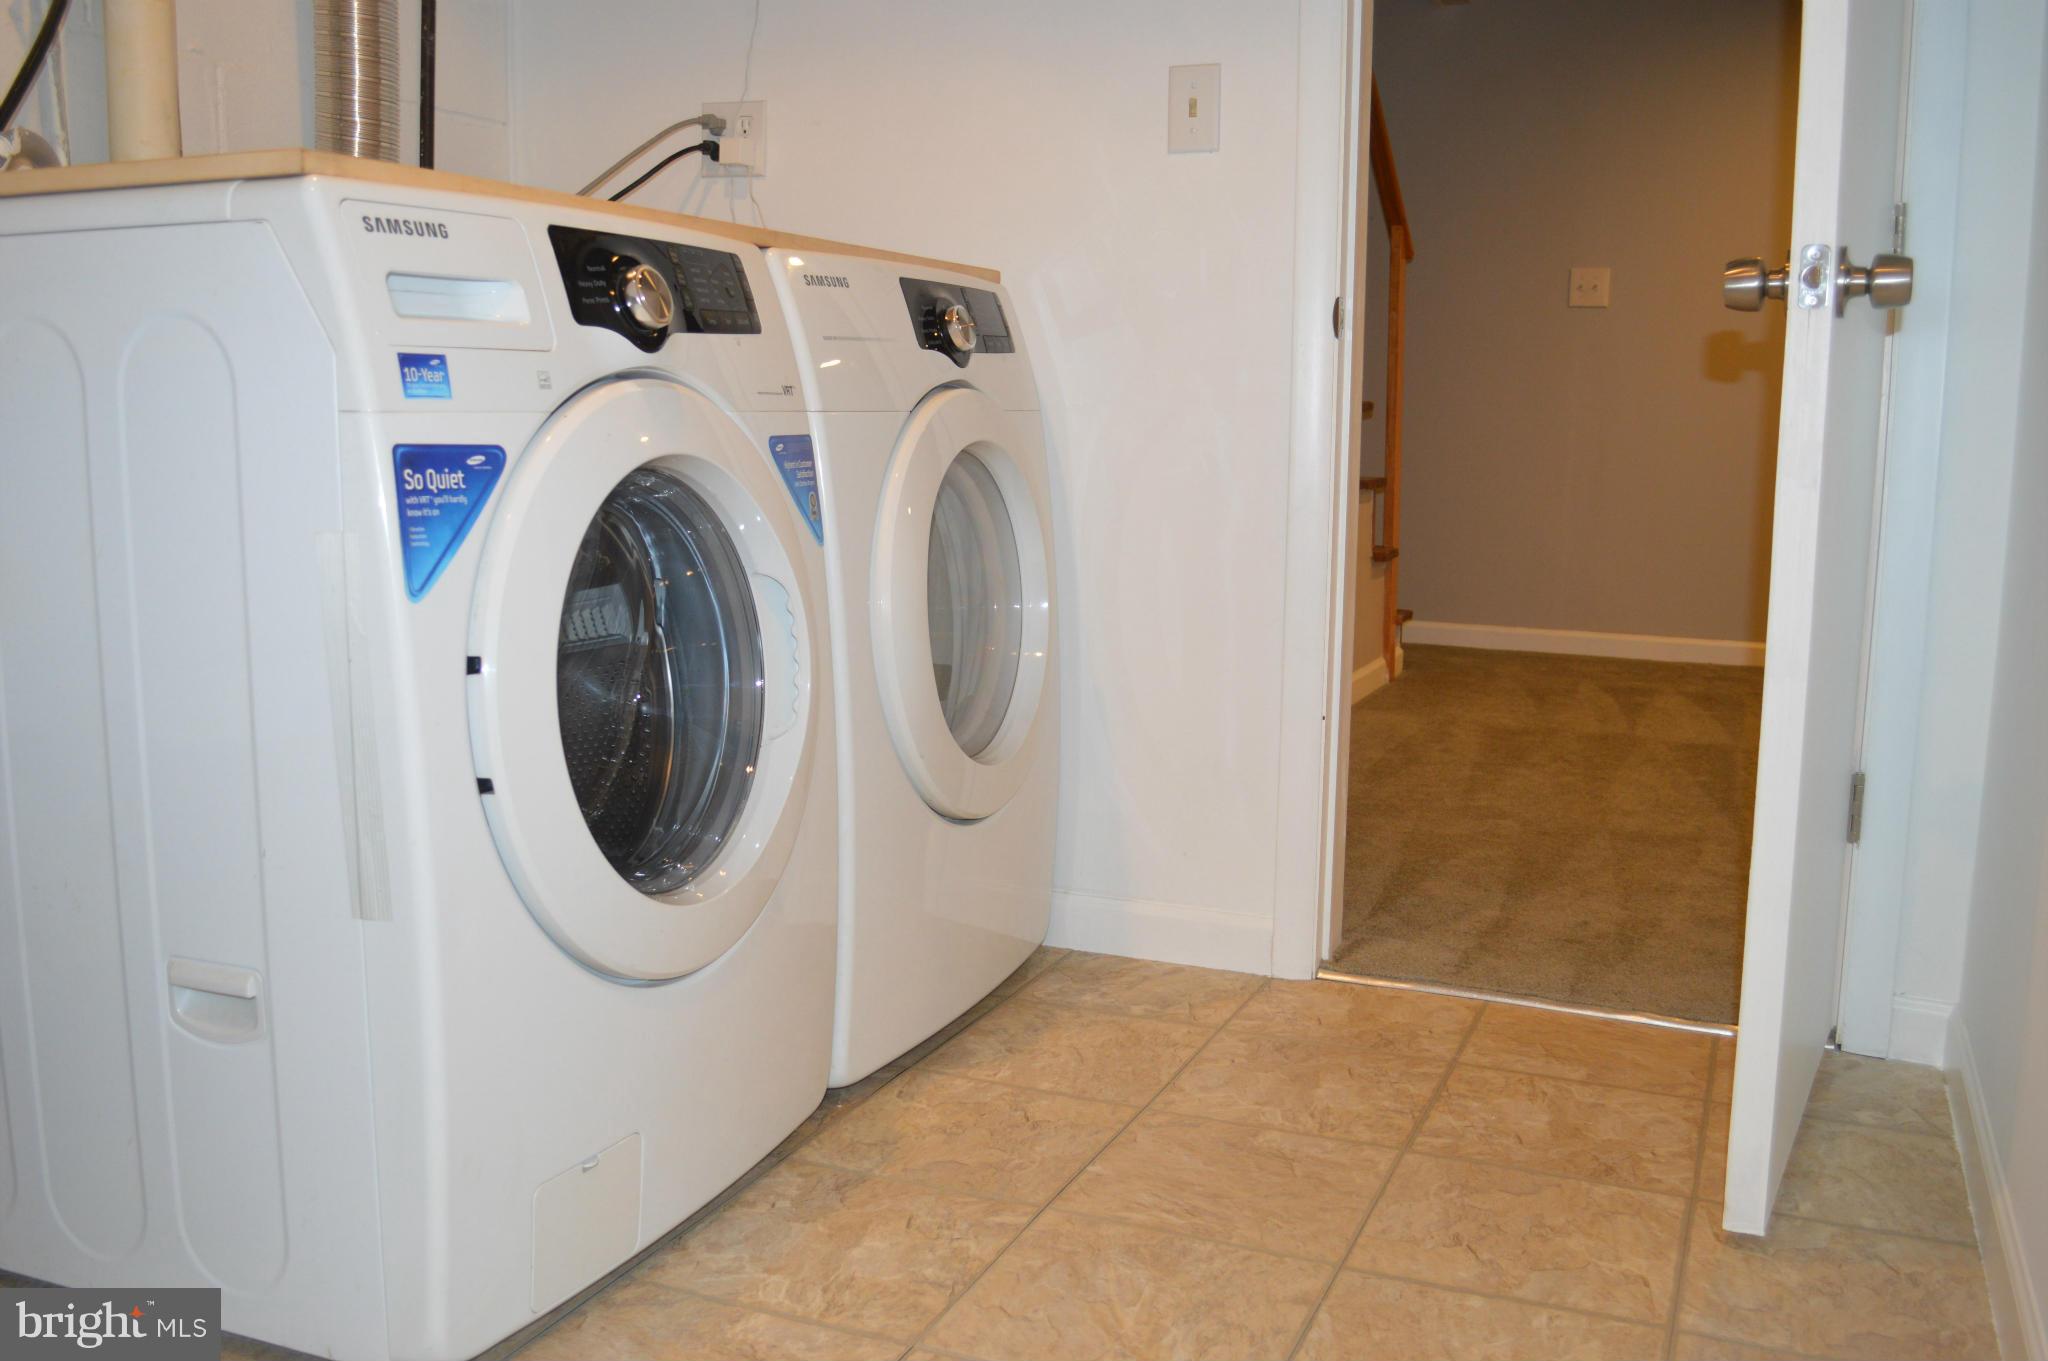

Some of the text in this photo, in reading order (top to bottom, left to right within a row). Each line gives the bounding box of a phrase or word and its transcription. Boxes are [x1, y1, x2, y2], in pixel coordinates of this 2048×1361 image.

[362, 215, 449, 239] SAMSUNG
[804, 274, 850, 288] SAMSUNG
[403, 367, 445, 383] 10-Year
[403, 468, 466, 493] So Quiet
